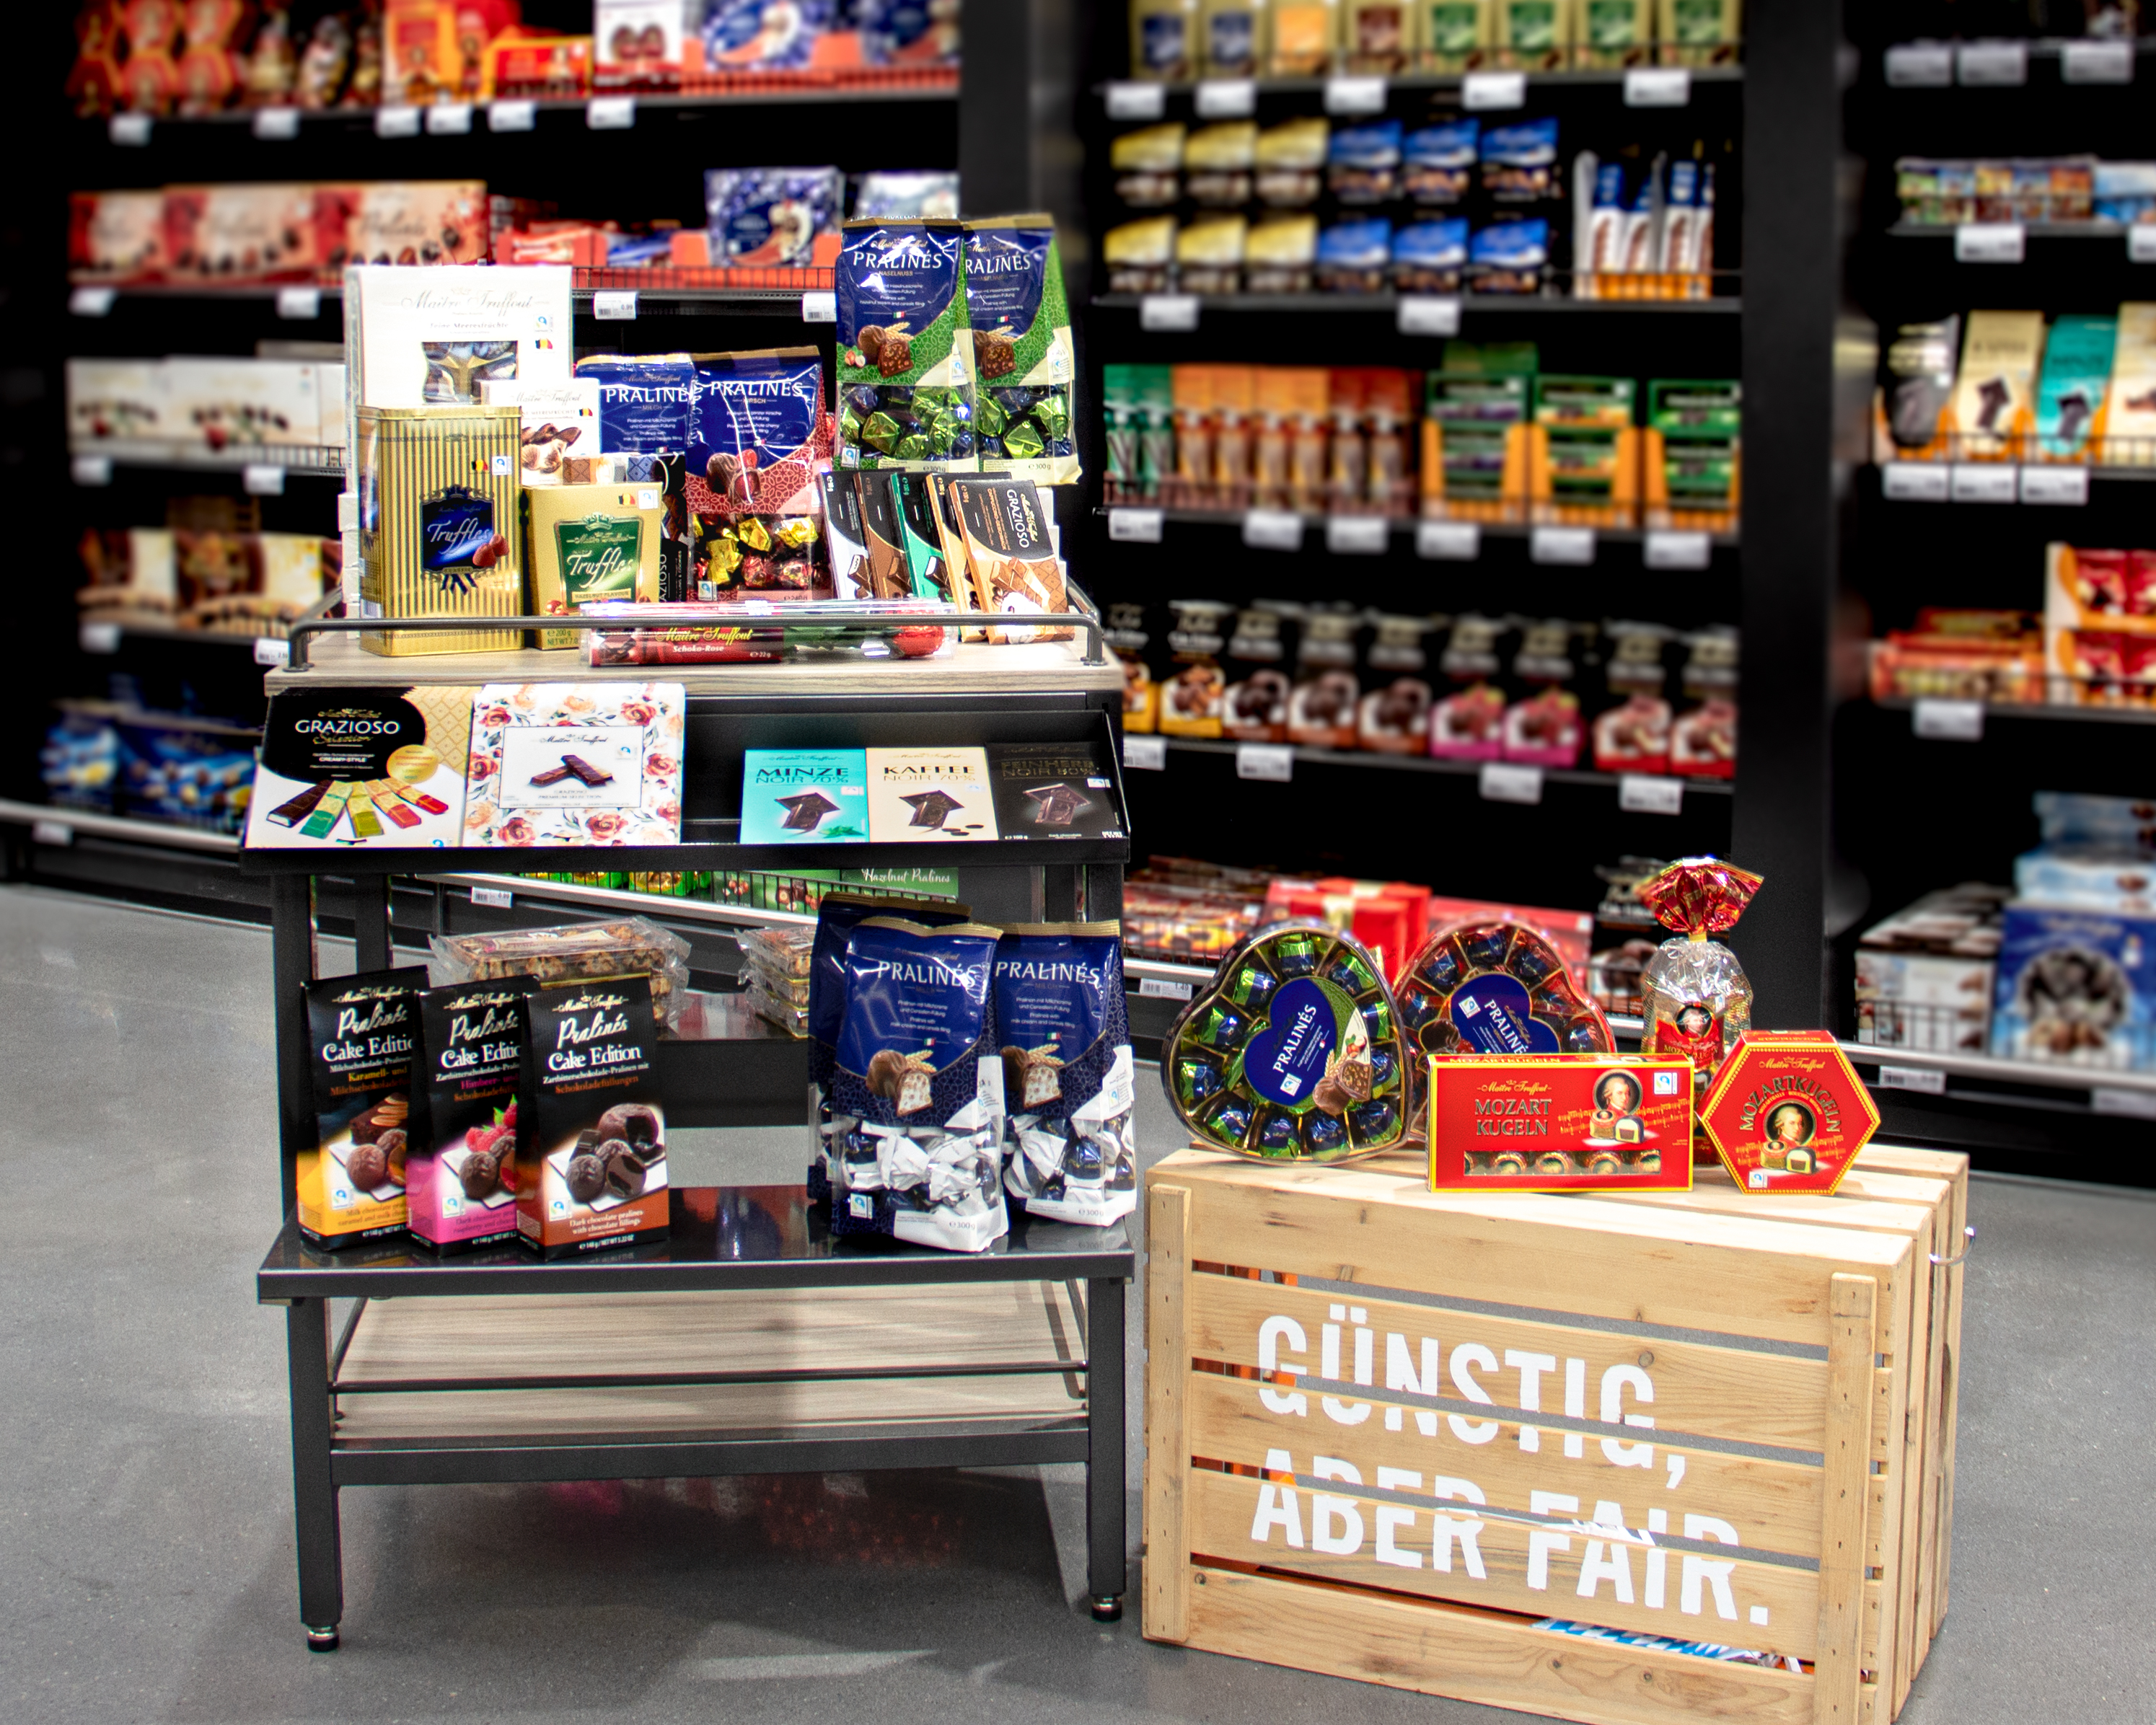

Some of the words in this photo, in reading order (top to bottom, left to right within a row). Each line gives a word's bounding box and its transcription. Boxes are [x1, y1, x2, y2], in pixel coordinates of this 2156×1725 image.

[853, 249, 942, 269] PRALINÉS
[965, 251, 1031, 274] RALINÉS
[606, 382, 689, 403] PRALINÉ
[1006, 488, 1030, 548] GRAZIOSO
[427, 516, 490, 556] Truffles
[566, 546, 634, 589] Truffles
[703, 627, 754, 646] Truffout
[294, 719, 401, 735] GRAZIOSO
[312, 731, 374, 745] Selection
[757, 767, 849, 777] MINZE
[884, 766, 975, 775] KAFFEE
[1001, 759, 1096, 769] FEINHERB
[1002, 768, 1051, 777] NOIR
[862, 868, 908, 881] Hazelnut
[911, 868, 950, 883] Pralines
[877, 960, 976, 988] PRALINÉS
[995, 961, 1101, 984] PRALINÉS
[337, 1001, 408, 1040] Pralinés
[449, 1007, 519, 1046] Pralinés
[557, 1010, 630, 1050] Pralinés
[1483, 998, 1530, 1054] PRALINÉ
[322, 1040, 366, 1062] Cake
[367, 1033, 413, 1056] Editio
[1272, 1003, 1317, 1074] PRALINÉS
[440, 1047, 479, 1069] Cake
[481, 1041, 521, 1063] Editio
[548, 1050, 587, 1072] Cake
[589, 1044, 642, 1066] Edition
[348, 1067, 390, 1082] Karamell-
[392, 1064, 408, 1076] und
[460, 1077, 501, 1090] Himbeer-
[542, 1065, 637, 1085] Zartbitterschokolade-Pralinen
[637, 1062, 649, 1071] mit
[555, 1075, 639, 1095] Schokoladefüllungen
[1480, 1081, 1513, 1093] Maître
[1514, 1080, 1549, 1096] Truffout
[1474, 1098, 1552, 1116] MOZART
[1739, 1075, 1842, 1133] MOZARTKUGELN
[1476, 1119, 1549, 1137] KUGELN
[569, 1217, 586, 1227] Dark
[586, 1213, 617, 1226] chocolate
[618, 1208, 644, 1221] pralines
[572, 1225, 587, 1235] with
[587, 1221, 618, 1233] chocolate
[1257, 1304, 1686, 1490] GÜNSTIG,
[1251, 1448, 1487, 1581] ABER
[1527, 1489, 1769, 1626] FAIR.
